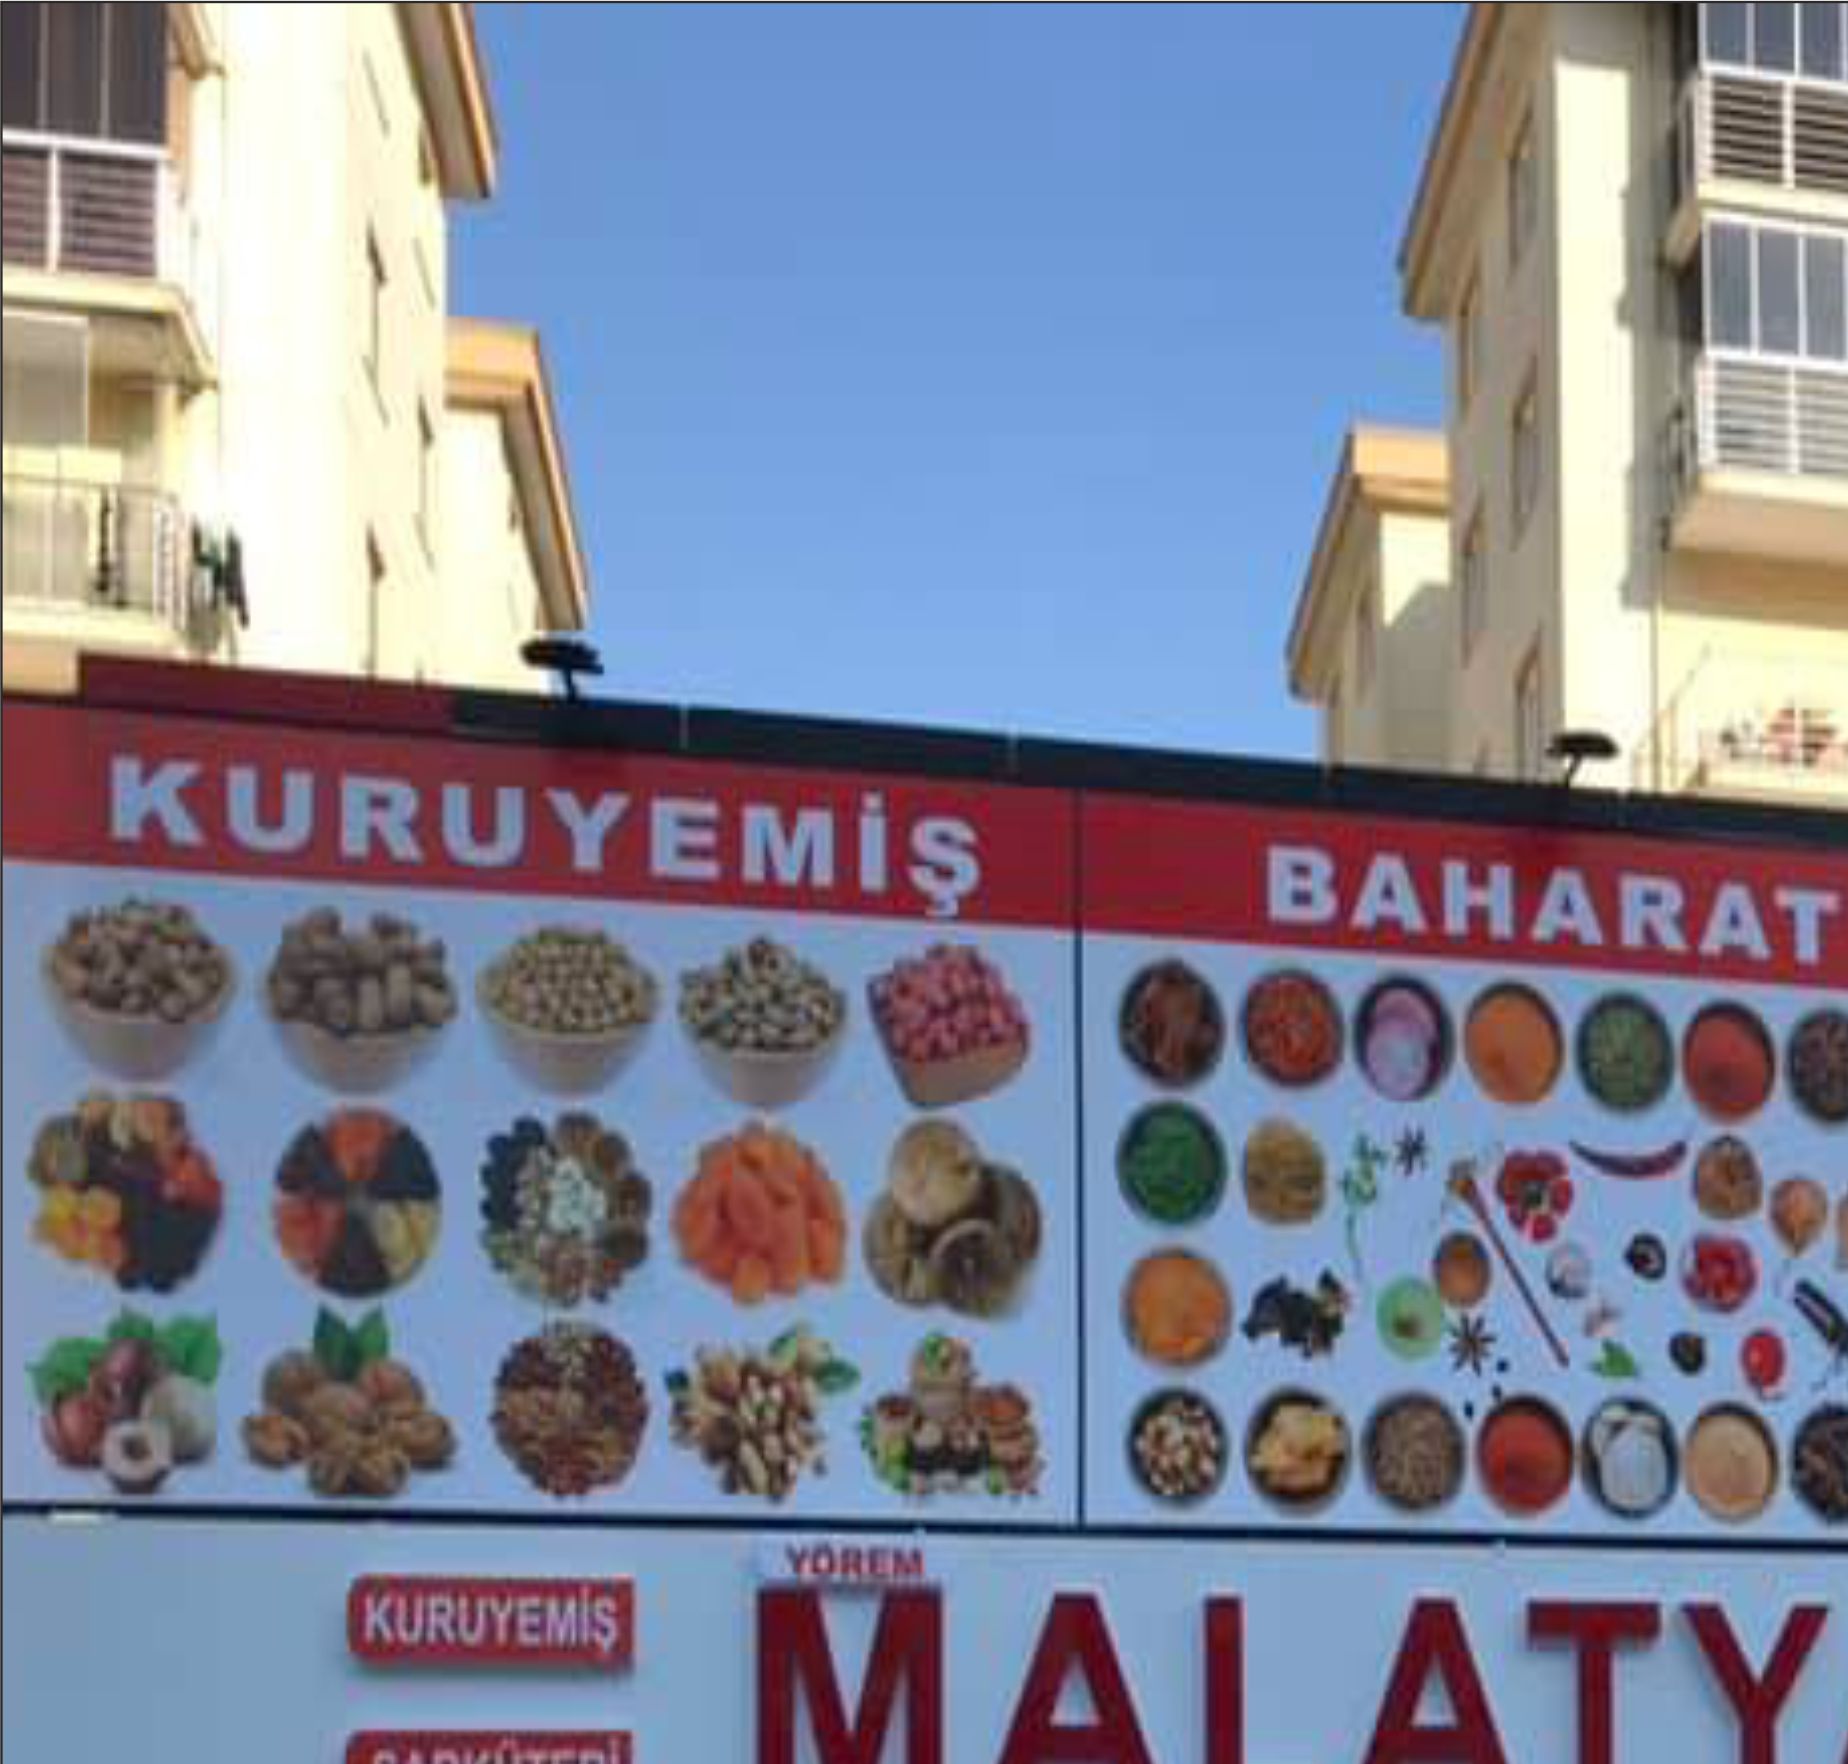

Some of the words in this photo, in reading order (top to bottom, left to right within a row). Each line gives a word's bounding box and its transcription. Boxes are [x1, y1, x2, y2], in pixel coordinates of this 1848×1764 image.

[109, 754, 982, 917] KURUYEMİŞ
[1265, 844, 1839, 966] BAHARAT
[785, 1543, 925, 1576] YÖREM
[363, 1584, 618, 1653] KURUYEMİŞ
